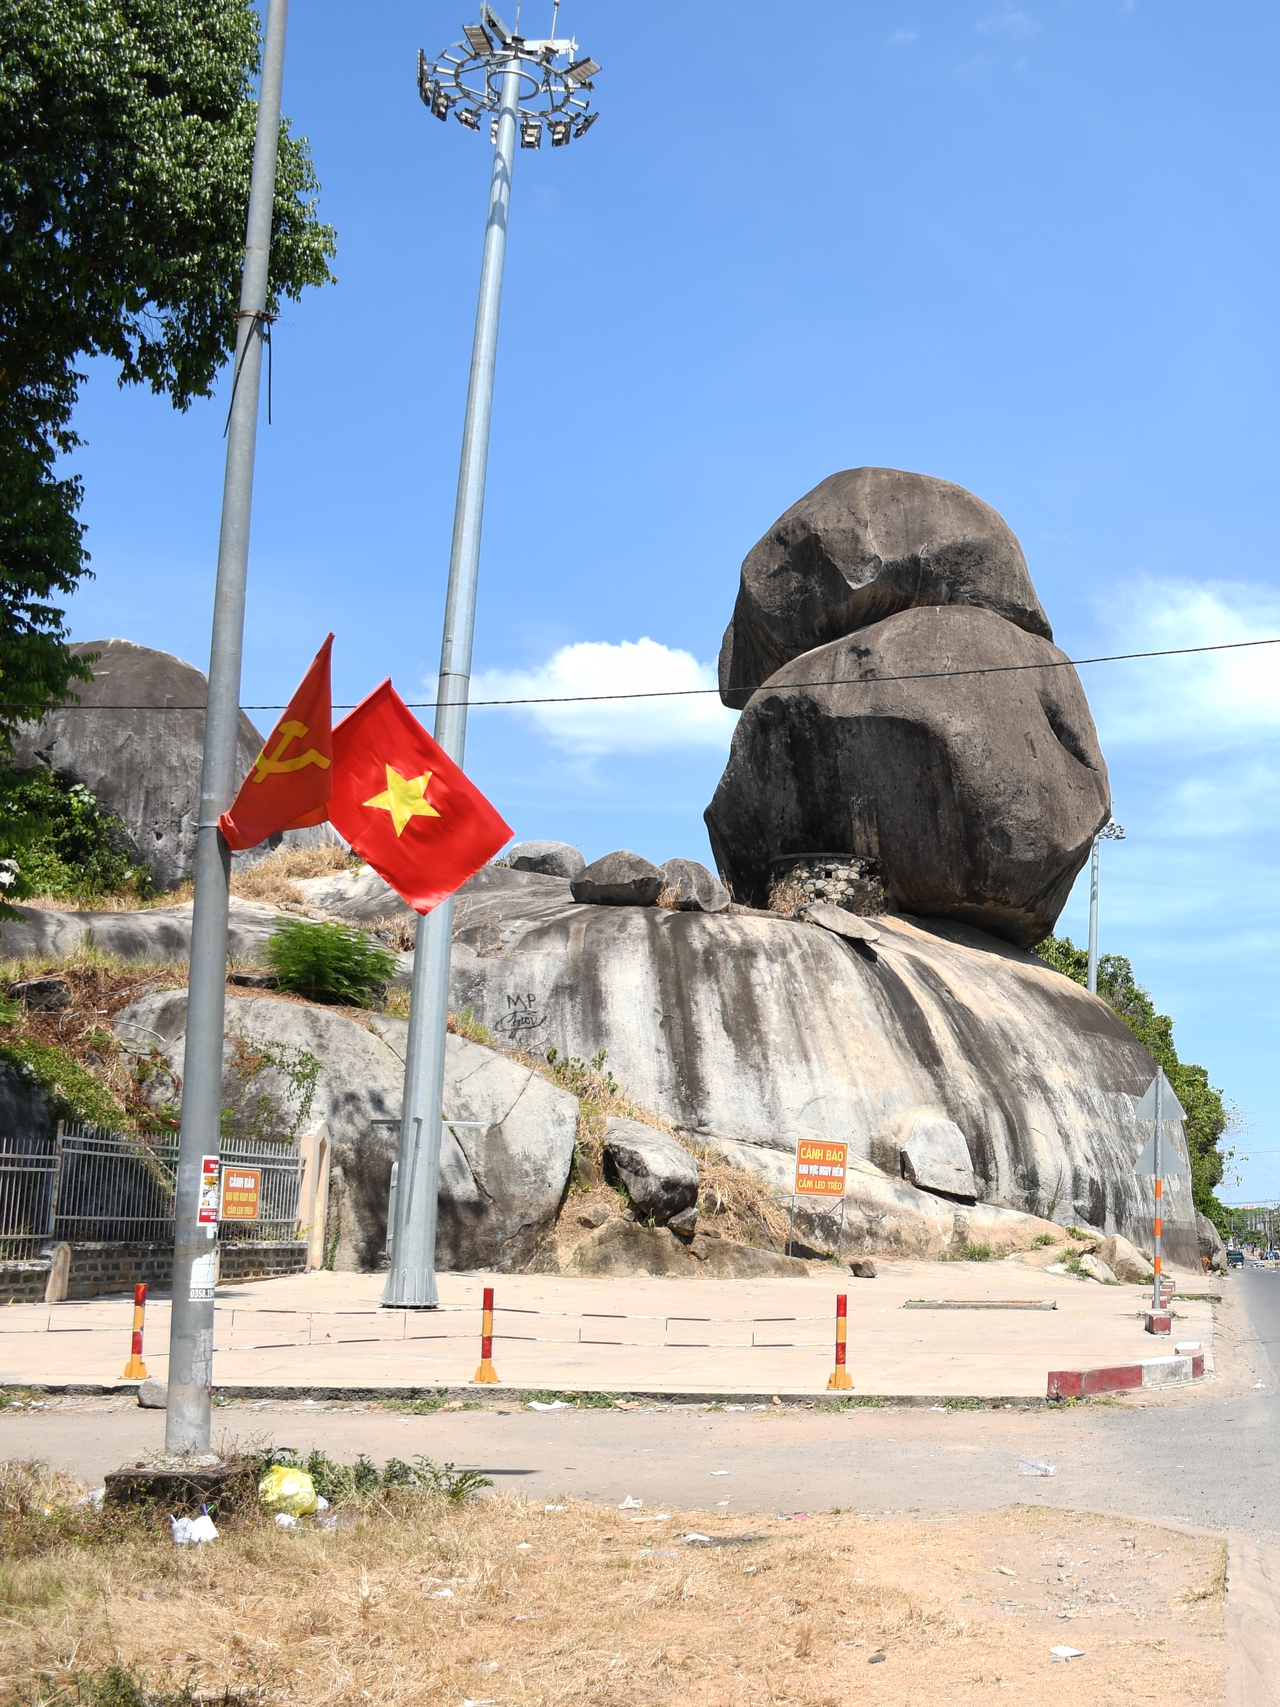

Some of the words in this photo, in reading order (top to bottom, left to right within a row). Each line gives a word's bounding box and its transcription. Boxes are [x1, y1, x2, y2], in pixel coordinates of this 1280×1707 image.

[800, 1145, 824, 1160] CẢNH
[826, 1148, 844, 1162] BÁO
[798, 1177, 813, 1188] CẤM
[815, 1180, 826, 1190] LEO
